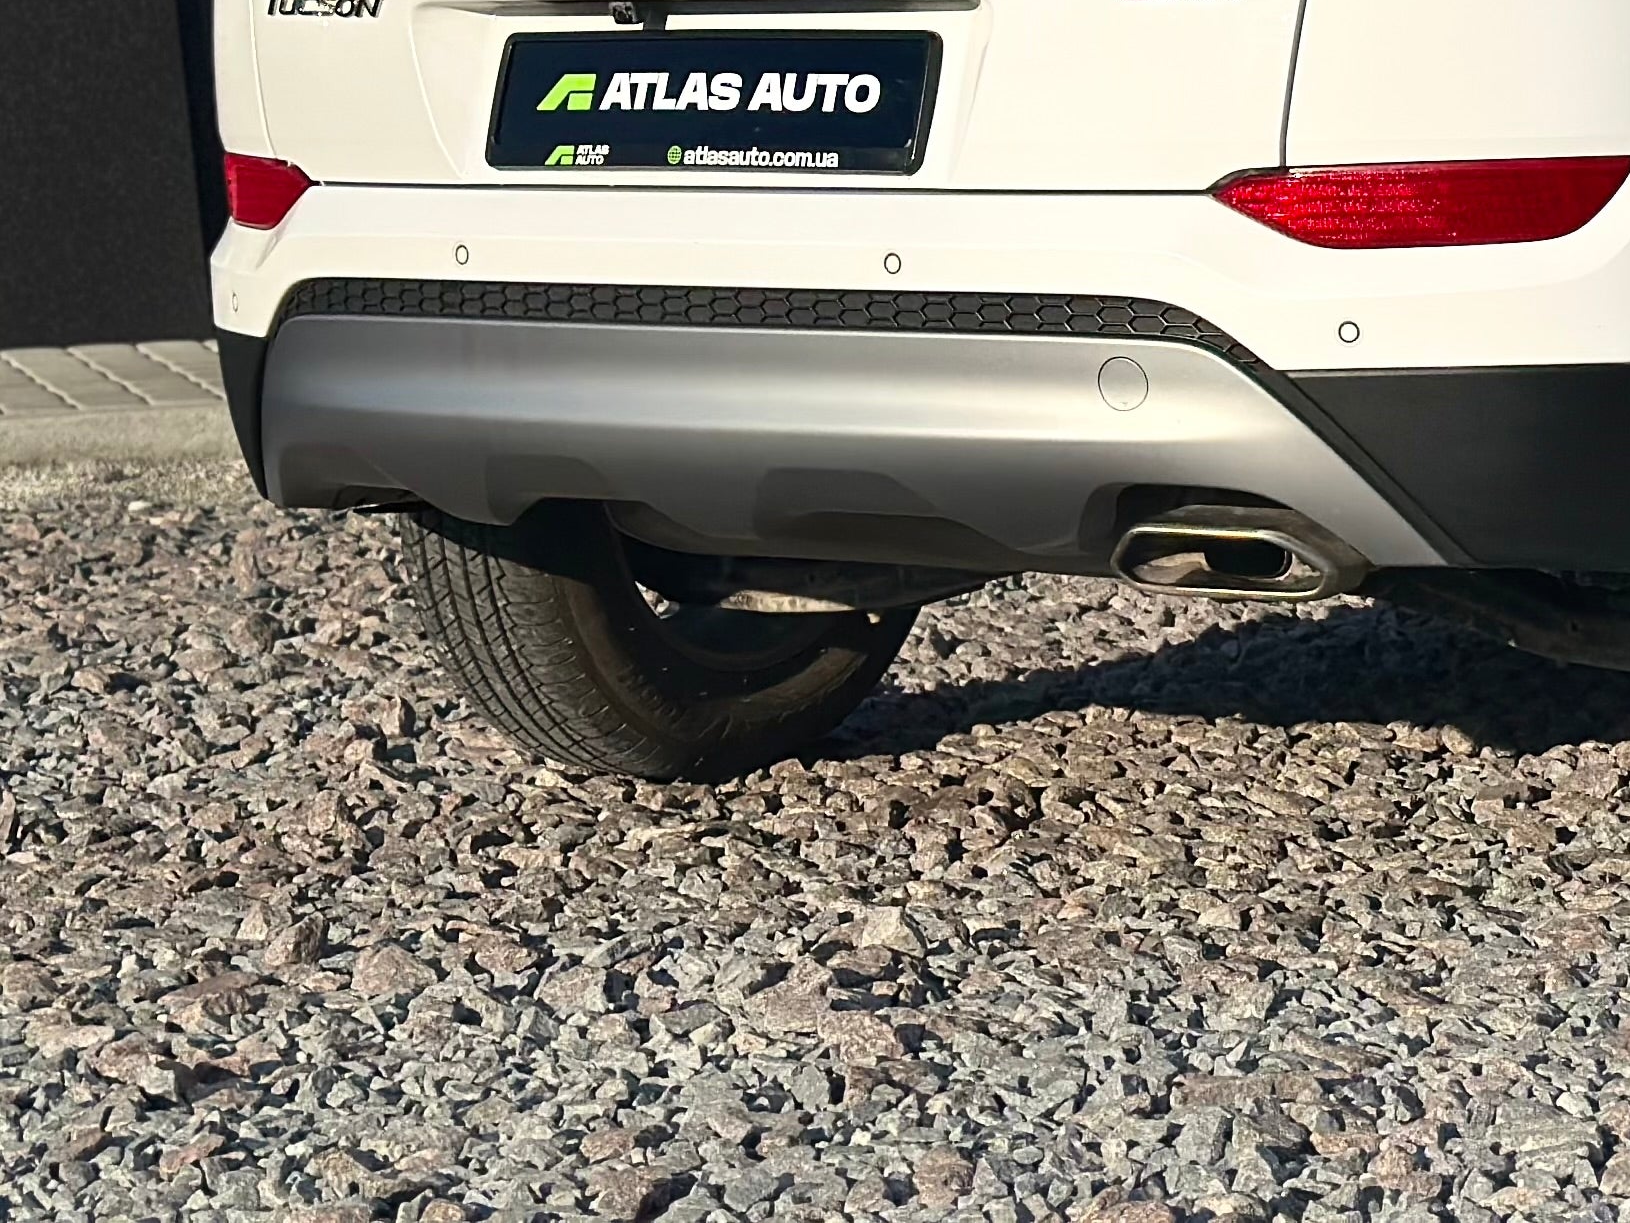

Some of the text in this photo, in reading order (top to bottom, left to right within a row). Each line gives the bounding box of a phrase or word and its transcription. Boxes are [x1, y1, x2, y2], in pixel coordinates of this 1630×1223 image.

[599, 72, 881, 113] ATLAS AUTO
[576, 144, 610, 155] ATLAS
[683, 145, 839, 167] atlasauto.com.ua
[574, 154, 605, 165] AUTO
